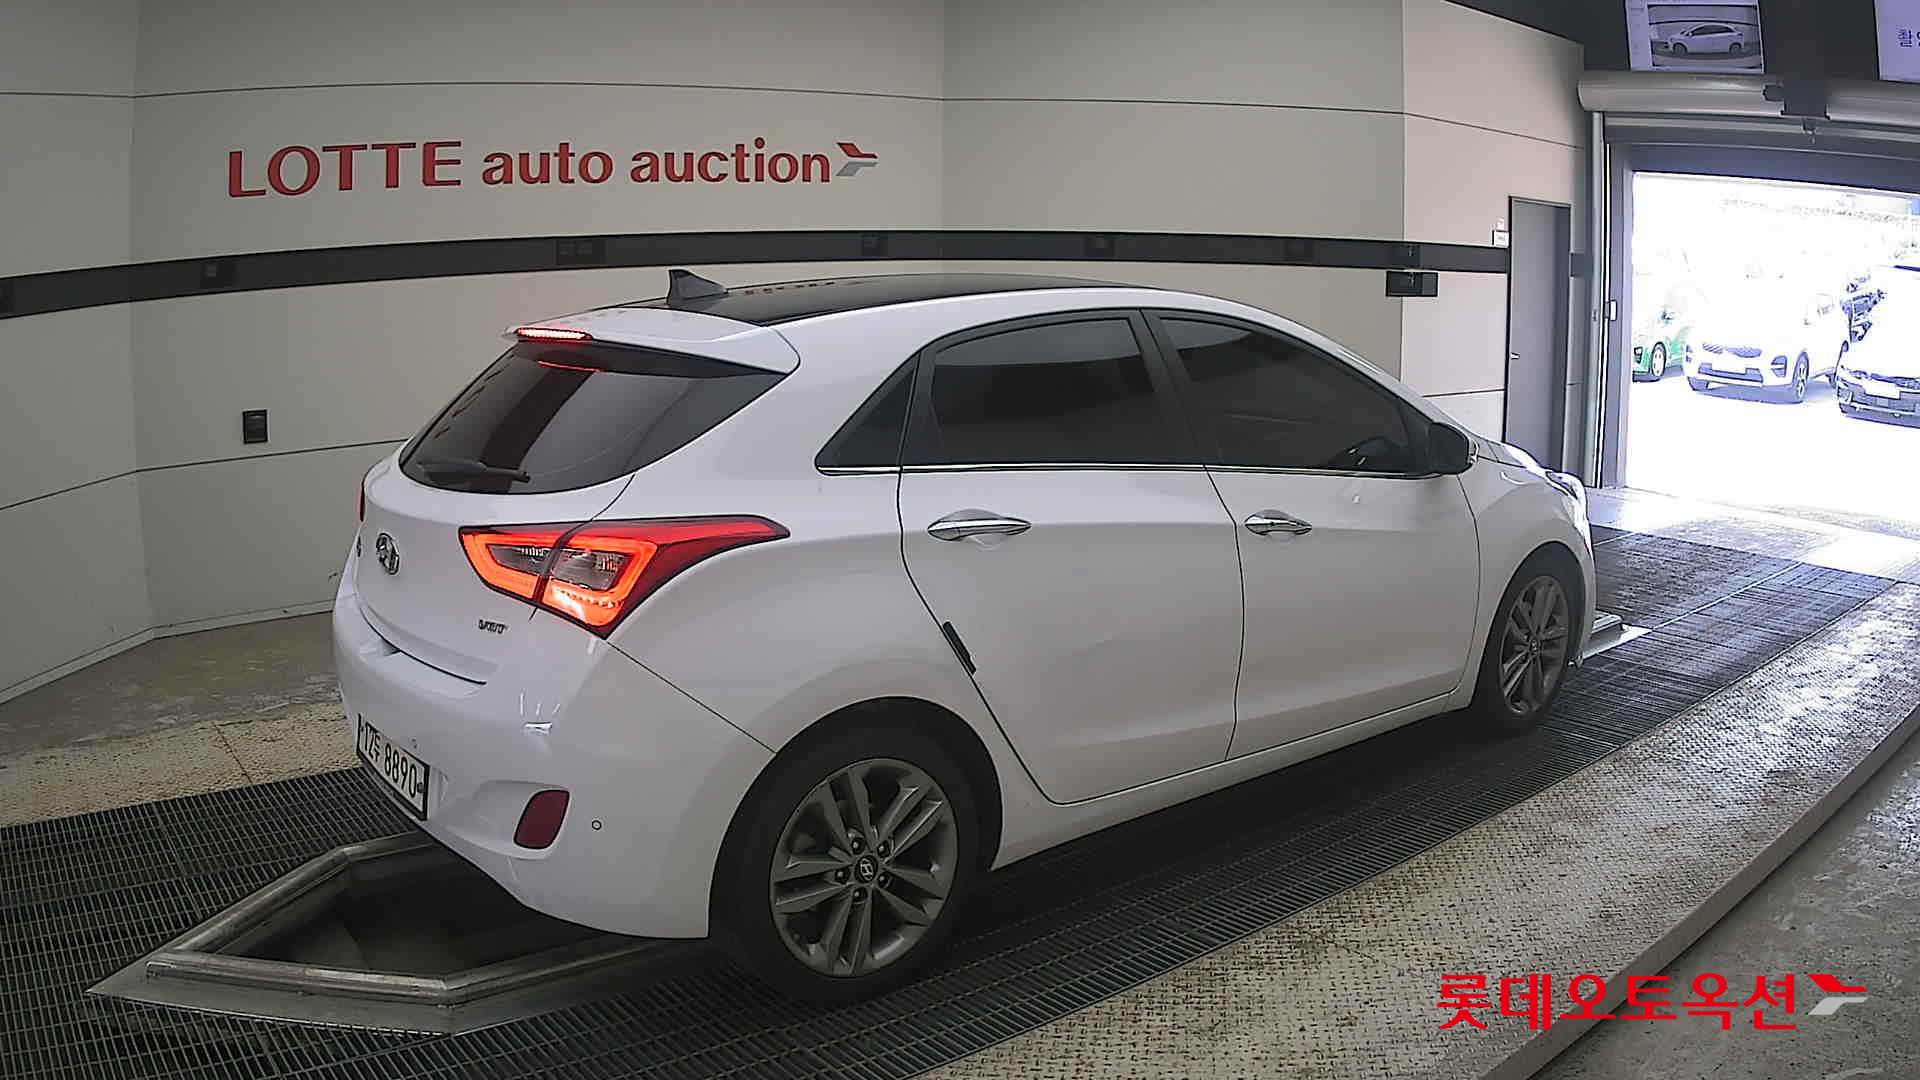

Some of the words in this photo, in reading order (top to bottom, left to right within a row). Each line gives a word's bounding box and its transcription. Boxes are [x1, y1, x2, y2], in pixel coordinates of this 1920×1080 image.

[228, 140, 462, 197] LOTTE
[481, 142, 613, 185] auto
[630, 136, 831, 183] auction
[385, 742, 417, 799] 8890
